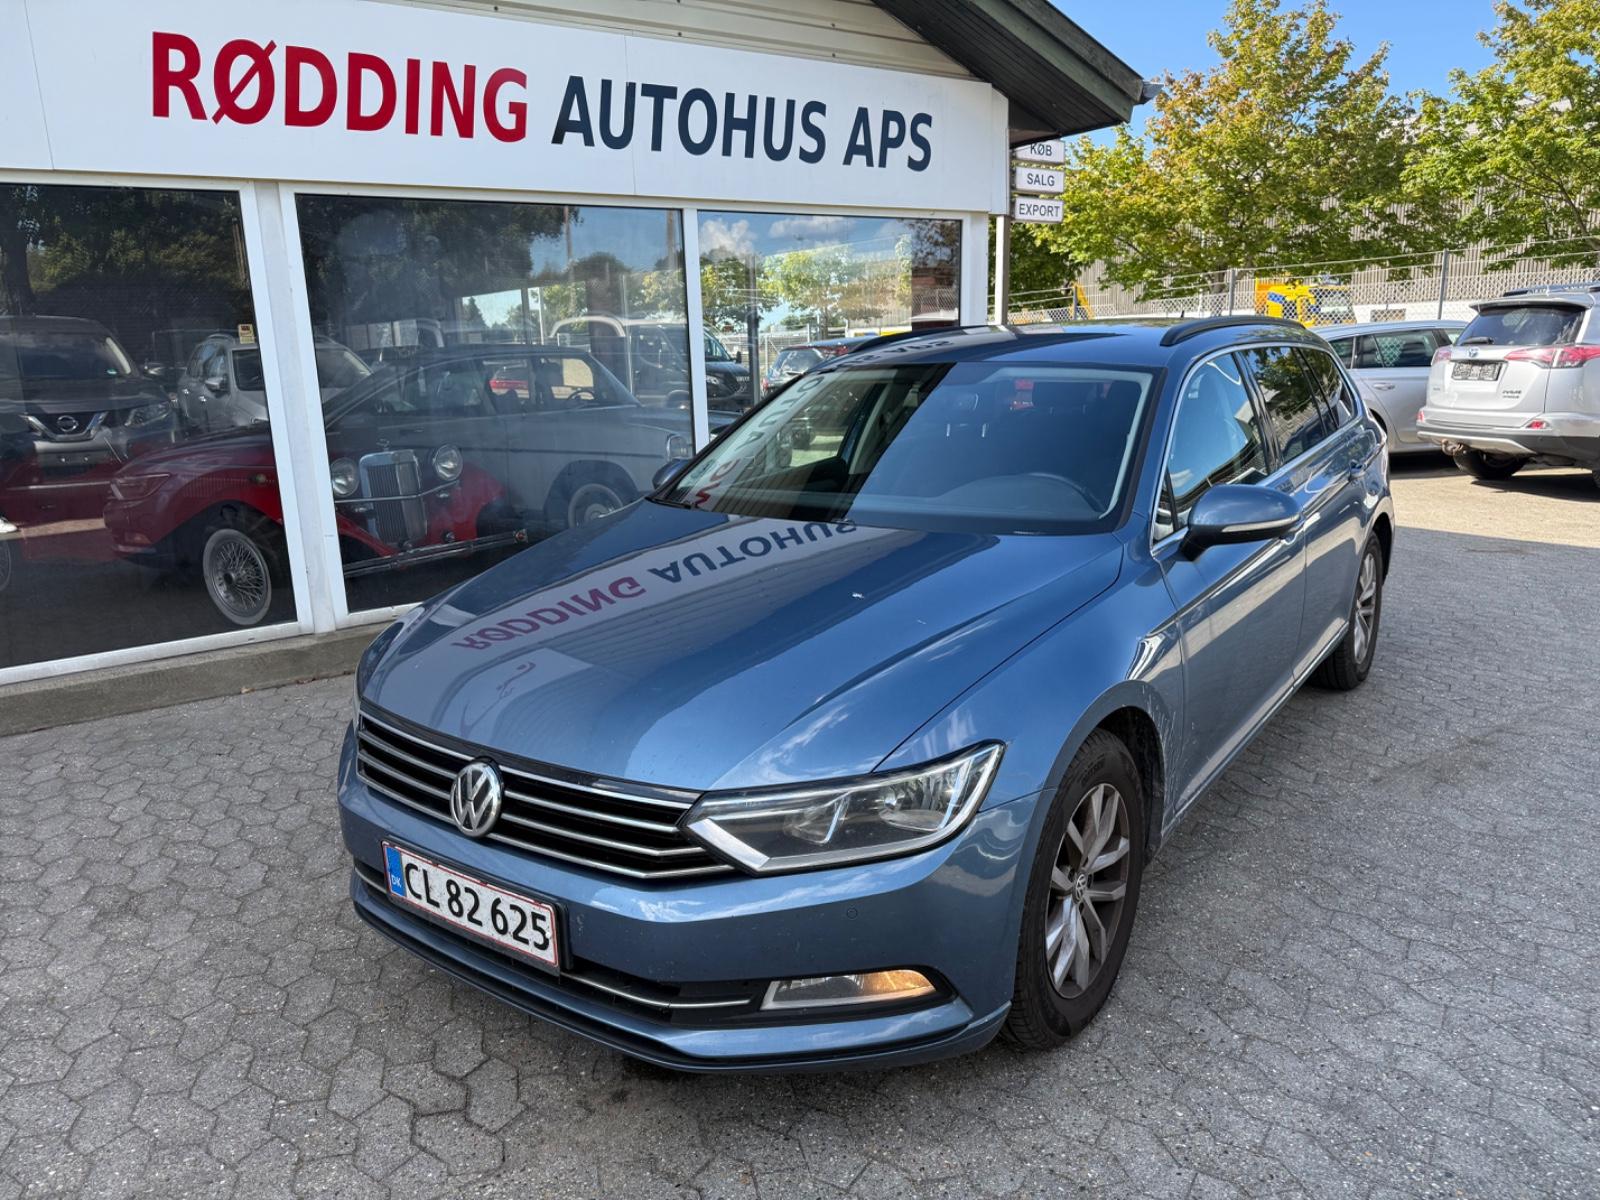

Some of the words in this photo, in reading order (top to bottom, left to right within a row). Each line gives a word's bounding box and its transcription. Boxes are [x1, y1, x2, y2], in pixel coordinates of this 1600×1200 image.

[152, 31, 528, 143] RØDDING
[551, 75, 827, 164] AUTOHUS
[842, 106, 933, 172] APS
[1030, 143, 1053, 157] KØB
[1026, 172, 1055, 187] SALG
[1019, 203, 1061, 218] EXPORT
[391, 874, 402, 888] DK
[404, 862, 440, 908] CL
[446, 879, 483, 927] 82
[491, 897, 550, 951] 625
